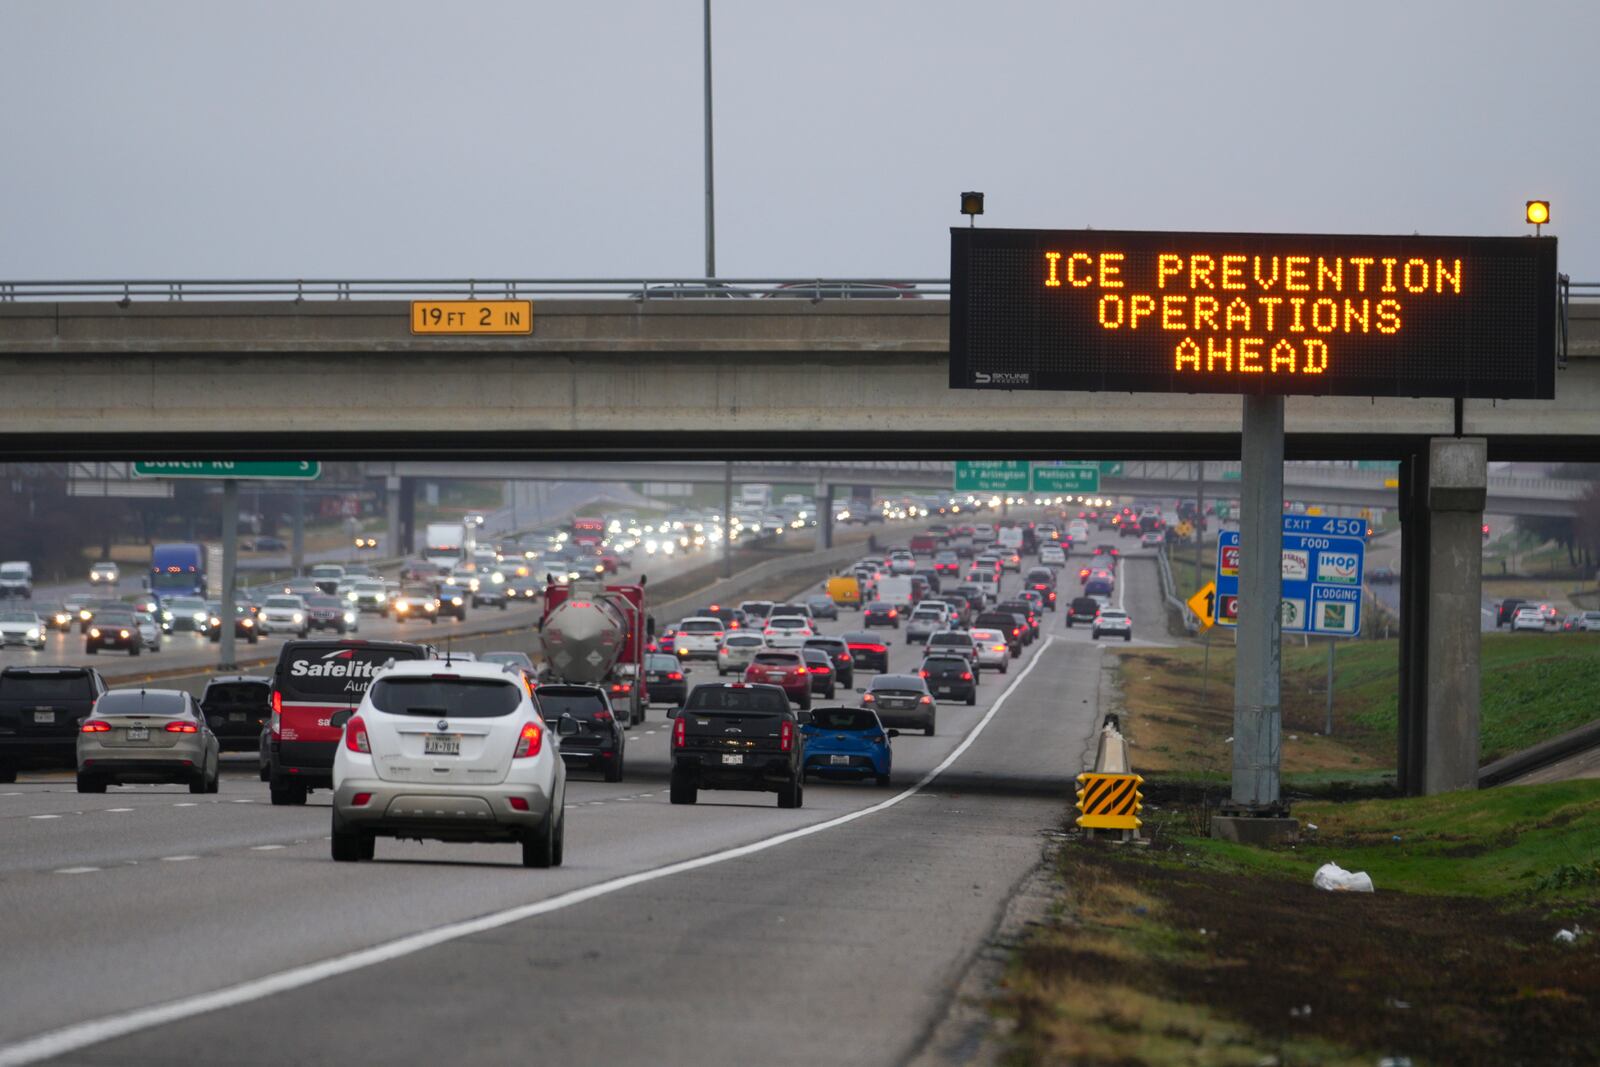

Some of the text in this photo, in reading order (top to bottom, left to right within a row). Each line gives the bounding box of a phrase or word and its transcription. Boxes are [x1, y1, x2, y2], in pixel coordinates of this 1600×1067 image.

[1045, 251, 1462, 295] ICE PREVENTION
[422, 307, 520, 326] 19 FT 2 IN
[1098, 293, 1401, 335] OPERATIONS
[1175, 336, 1328, 374] AHEAD
[980, 470, 1026, 480] Arlington
[1284, 518, 1360, 535] EXIT 450
[1301, 537, 1329, 549] FOOD
[1317, 588, 1357, 600] LODGING
[343, 680, 371, 692] Aut
